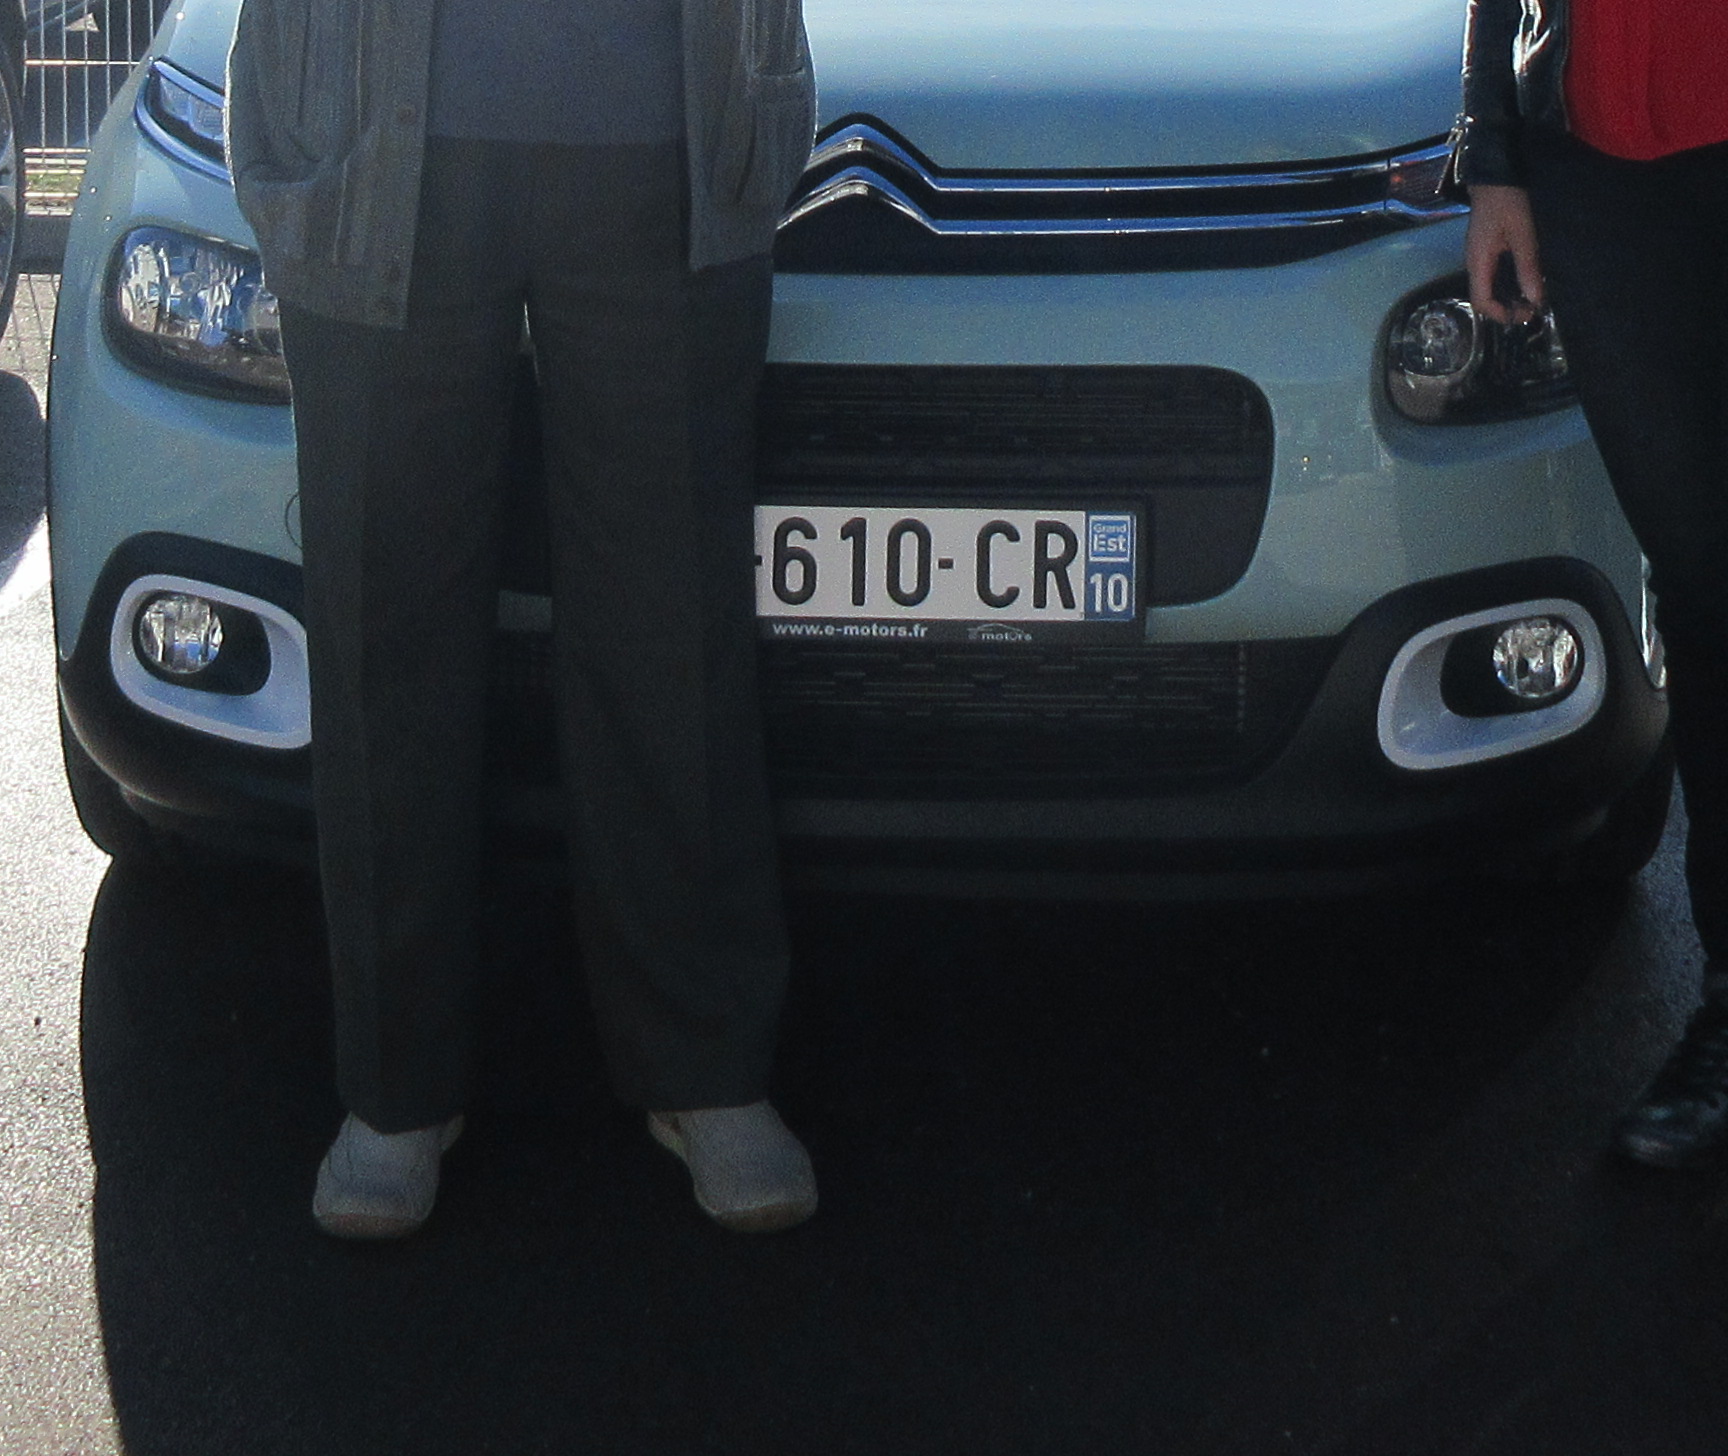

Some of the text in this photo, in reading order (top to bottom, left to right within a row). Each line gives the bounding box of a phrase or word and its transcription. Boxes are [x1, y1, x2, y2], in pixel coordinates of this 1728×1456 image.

[1093, 523, 1127, 533] Grand
[1093, 534, 1127, 552] Est
[1090, 573, 1128, 612] 10
[773, 623, 928, 637] www.e-motors.fr
